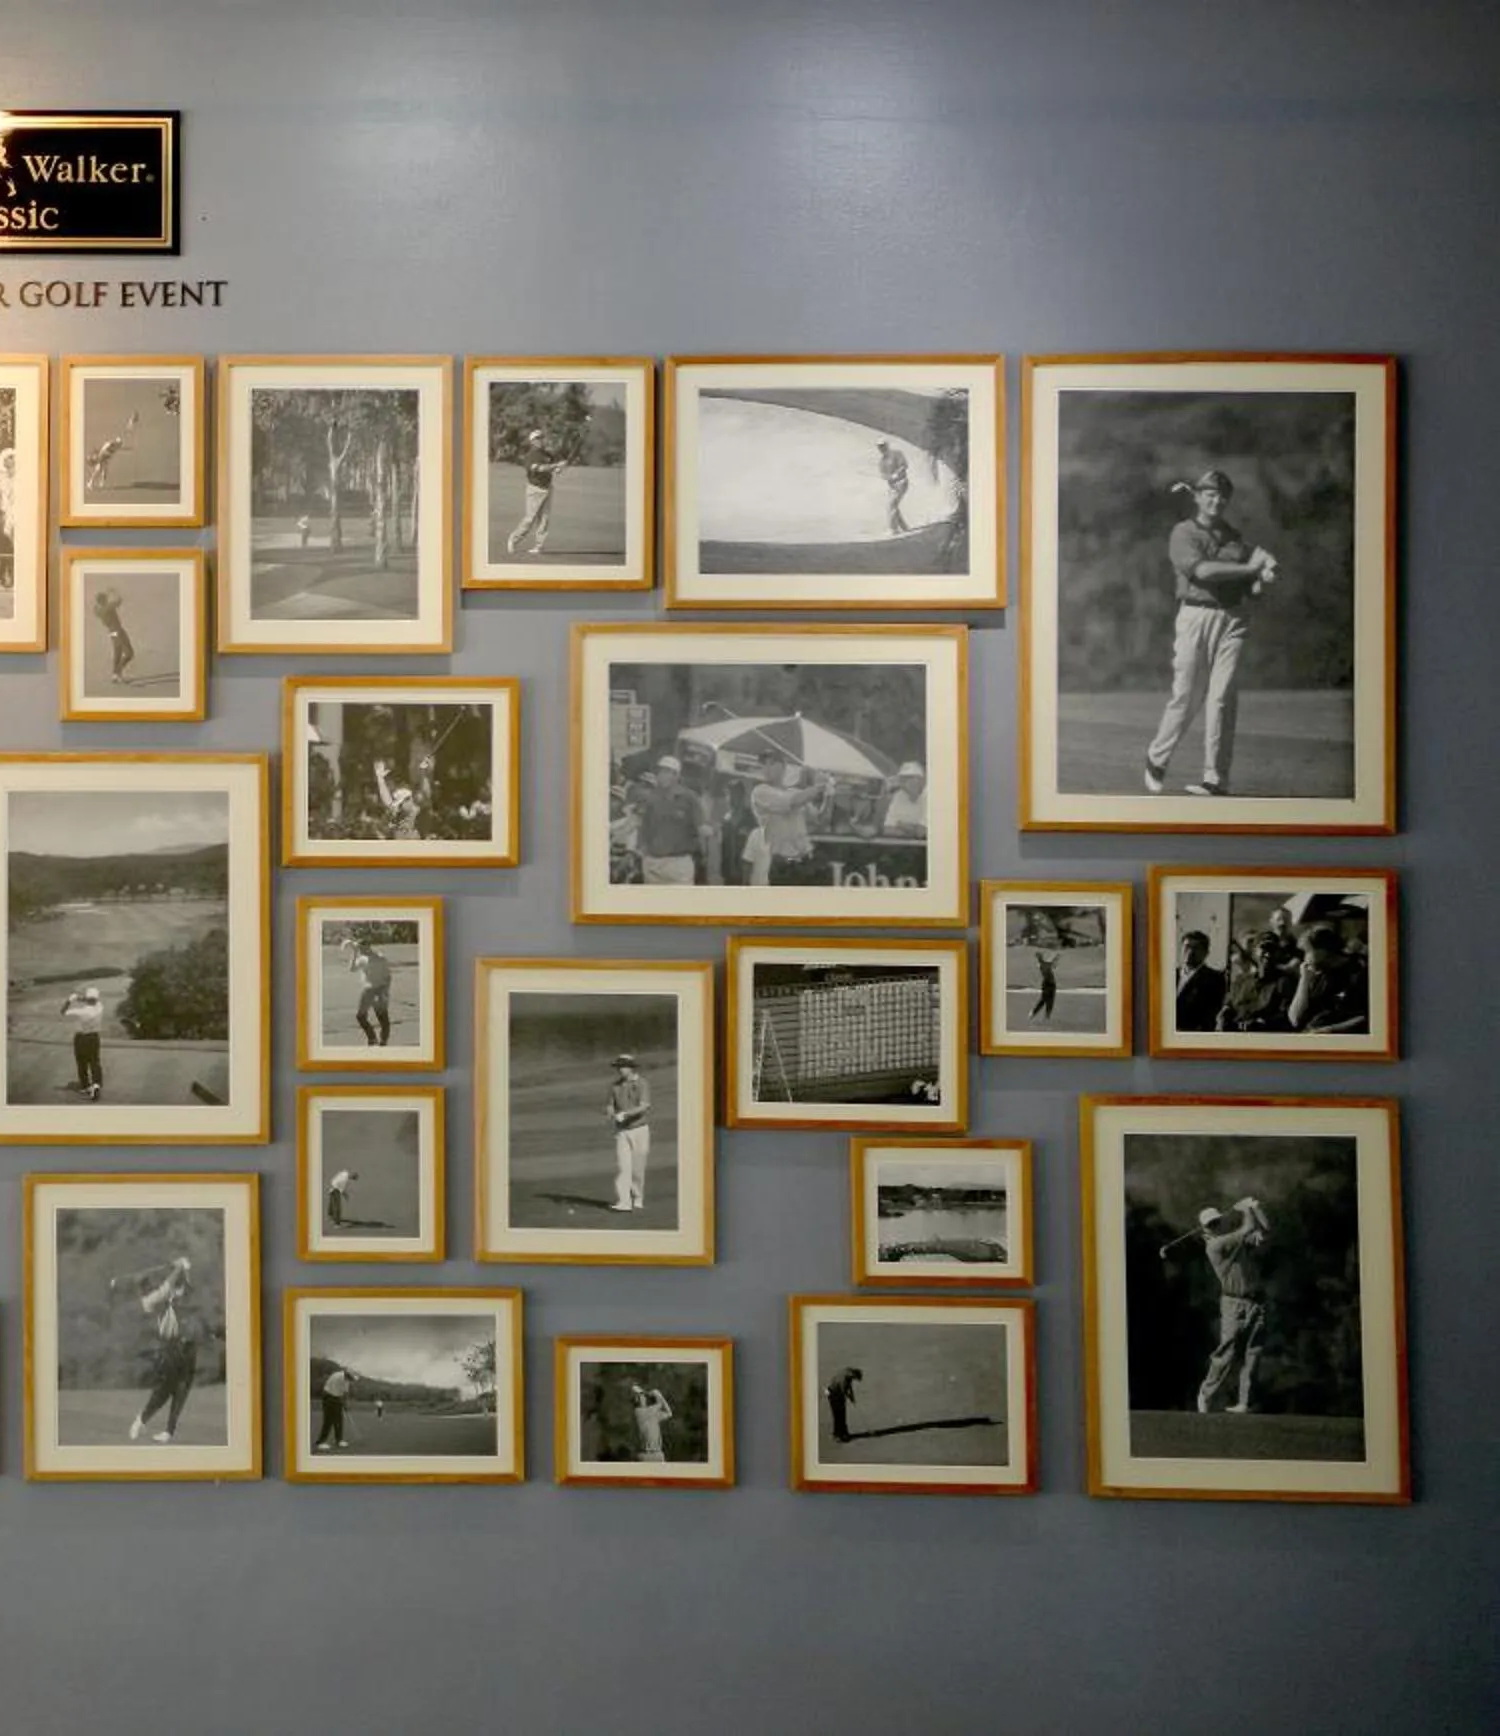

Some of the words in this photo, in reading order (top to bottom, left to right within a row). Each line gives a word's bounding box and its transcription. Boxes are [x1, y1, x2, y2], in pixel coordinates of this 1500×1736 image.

[19, 281, 109, 308] GOLF
[119, 281, 228, 308] EVENT
[828, 861, 928, 889] John
